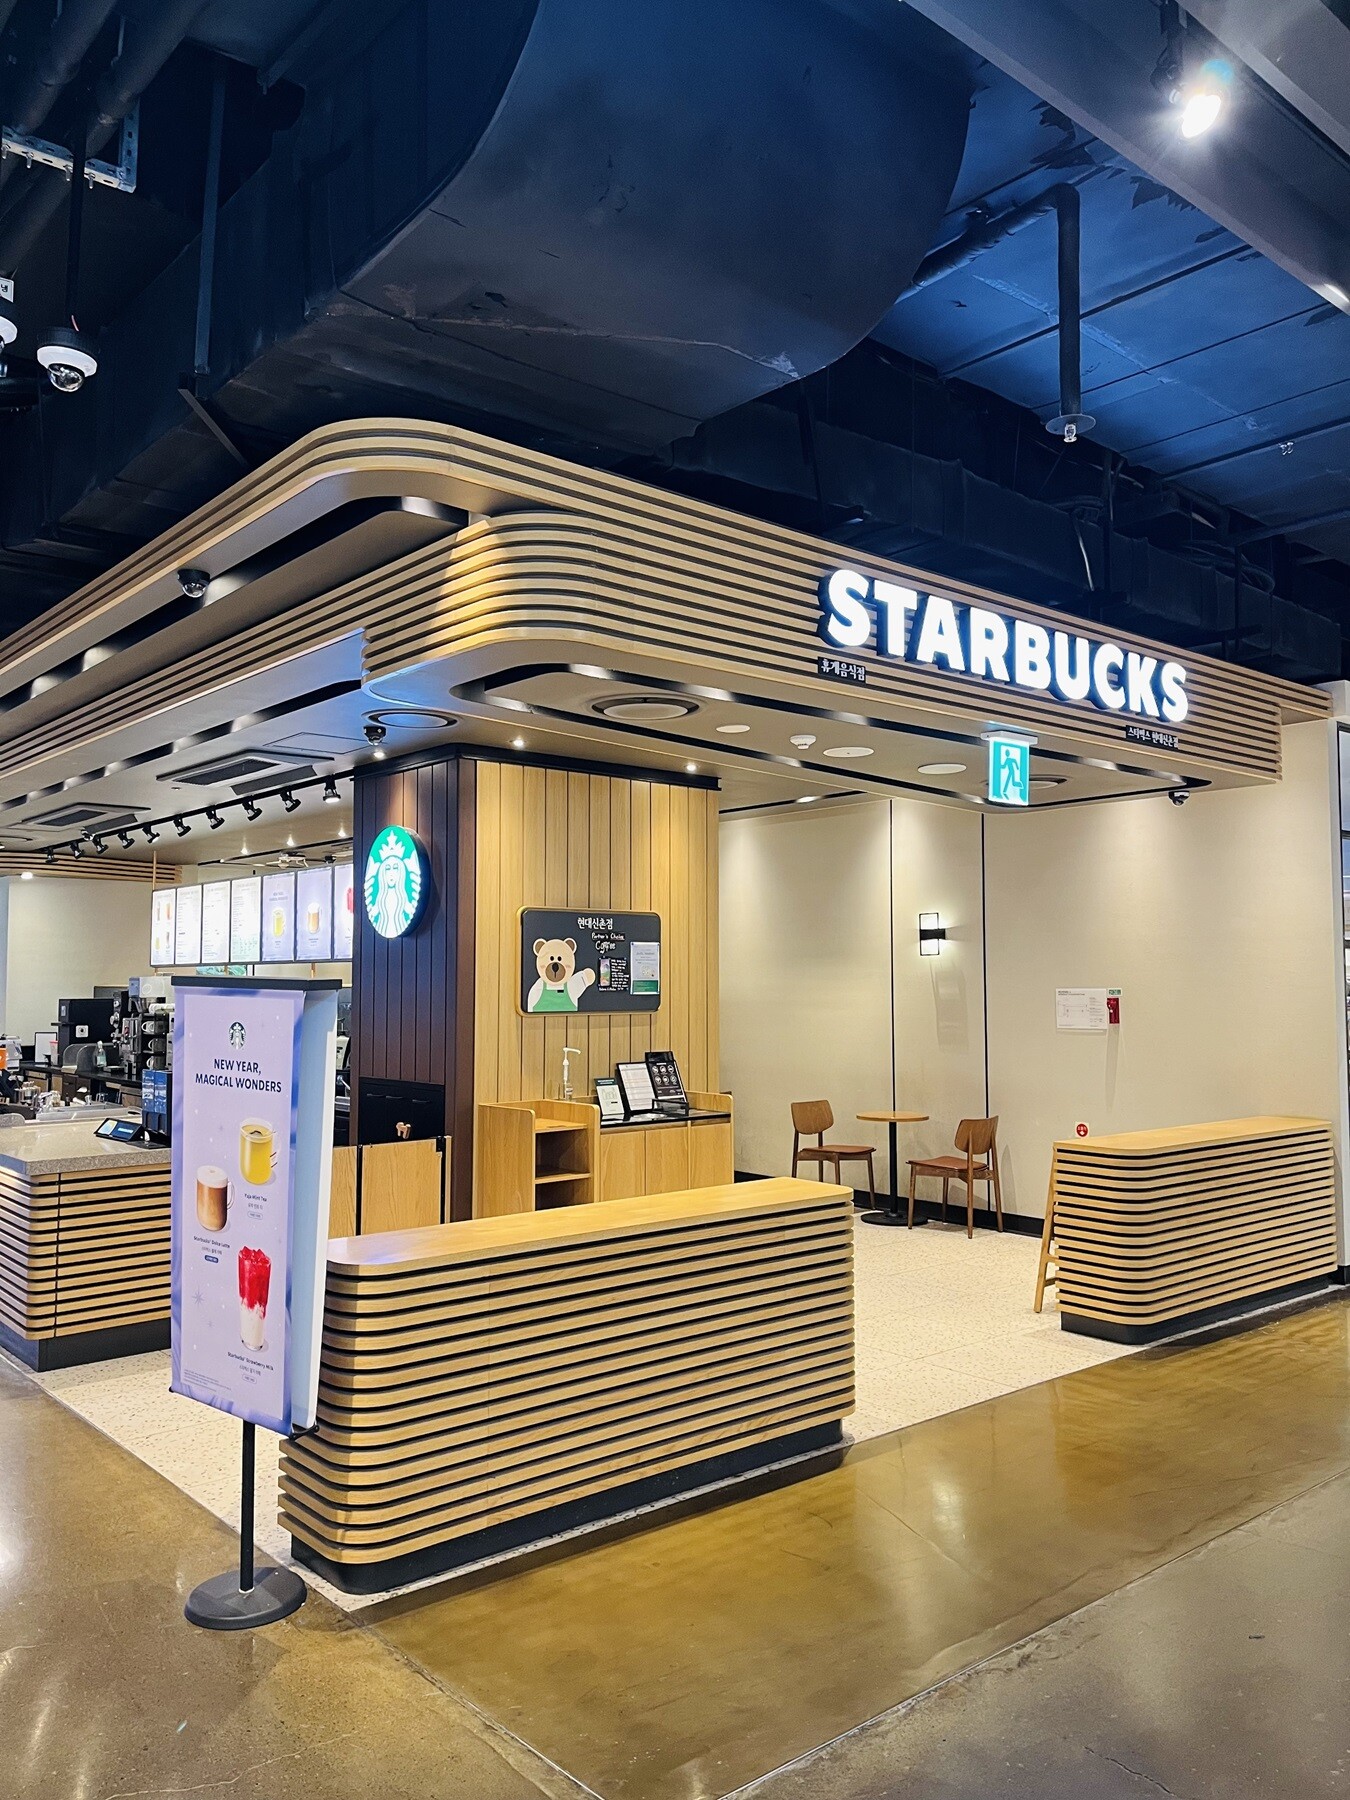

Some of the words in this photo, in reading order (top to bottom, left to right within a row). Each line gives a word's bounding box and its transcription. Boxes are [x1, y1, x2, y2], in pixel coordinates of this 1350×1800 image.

[828, 569, 1189, 722] STARBUCKS
[821, 658, 865, 681] 휴게음식점
[1128, 727, 1151, 741] 스타벅스
[1152, 731, 1179, 748] 현대신촌점
[577, 917, 613, 930] 현대신촌점
[214, 1058, 235, 1071] NEW
[235, 1060, 261, 1076] YEAR,
[195, 1073, 234, 1088] MAGICAL
[235, 1077, 282, 1093] WONDERS
